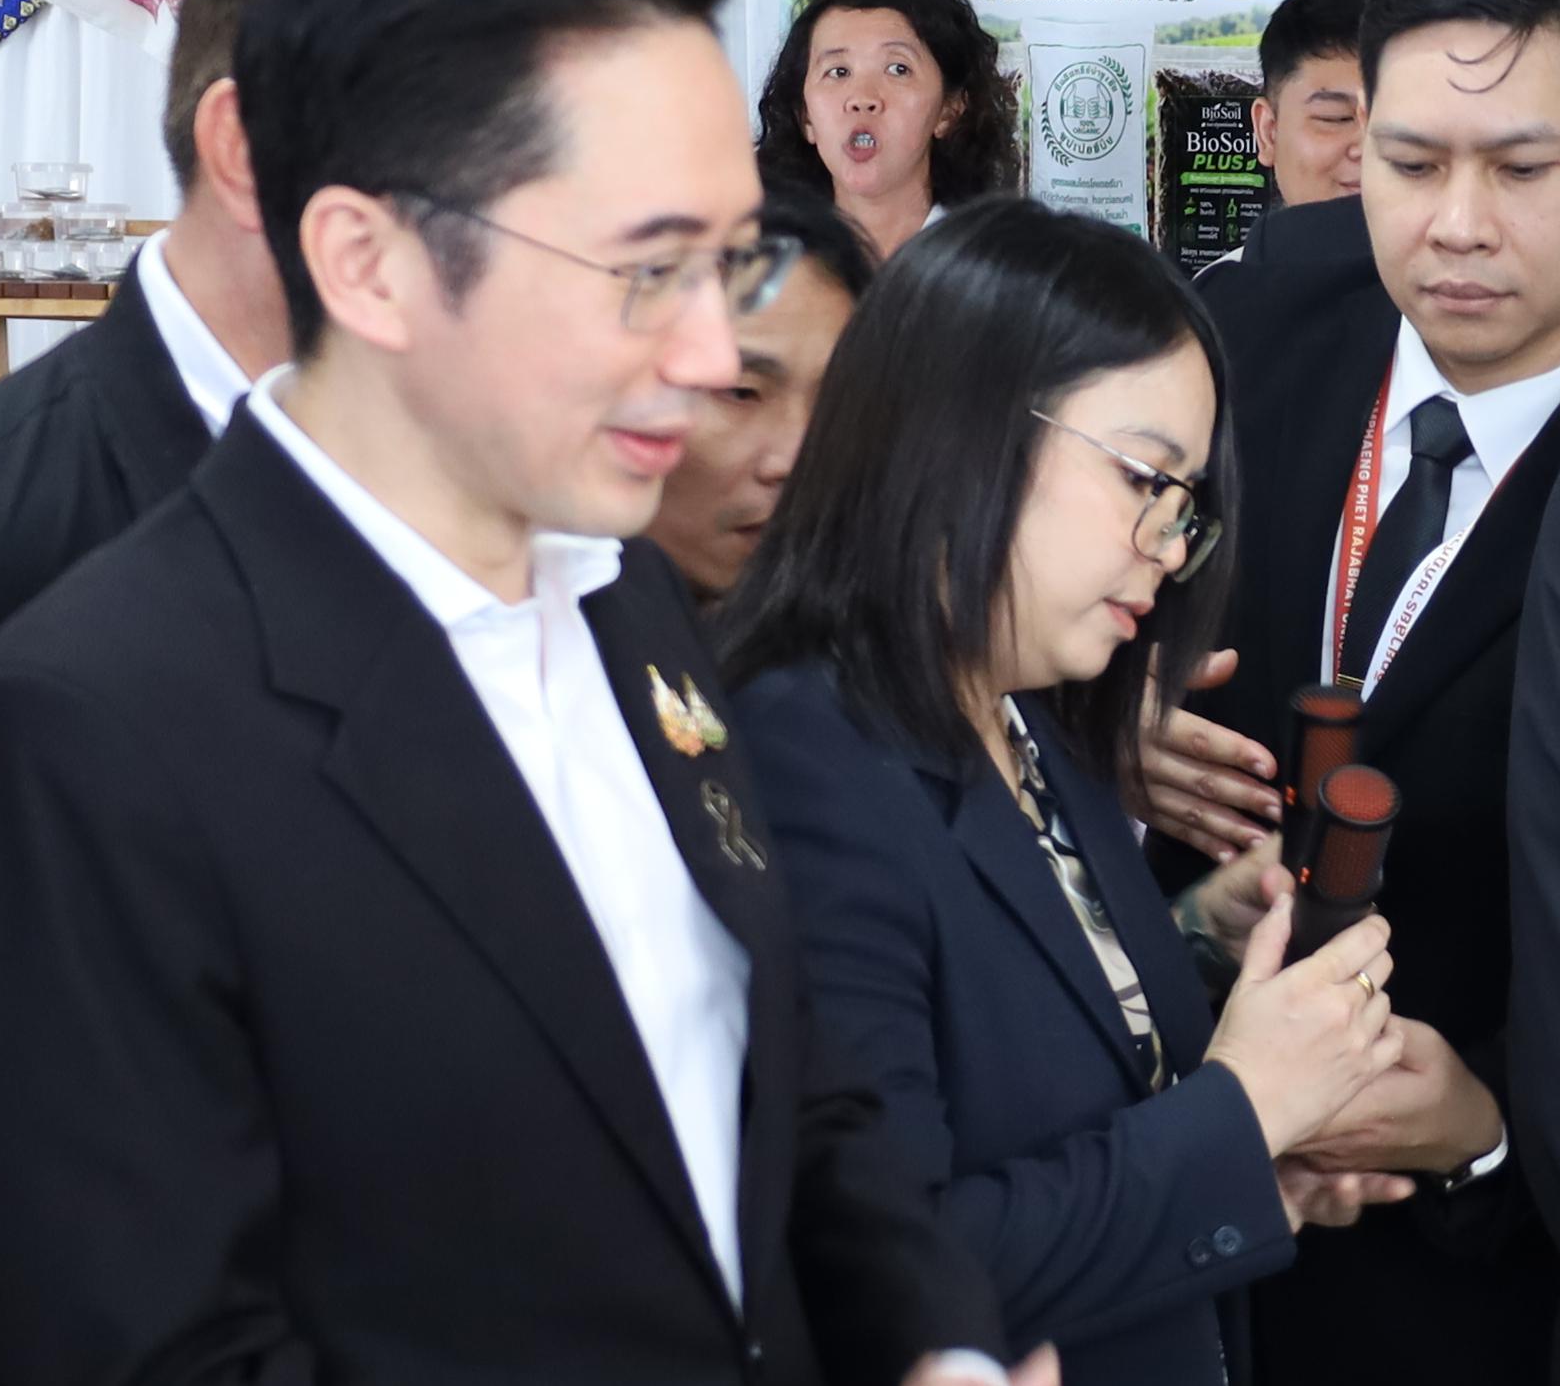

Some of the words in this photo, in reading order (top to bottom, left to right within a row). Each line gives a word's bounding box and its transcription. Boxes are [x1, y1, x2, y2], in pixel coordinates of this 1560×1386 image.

[1186, 131, 1257, 153] BioSoil
[1192, 153, 1244, 171] PLUS
[1353, 483, 1371, 524] PHET
